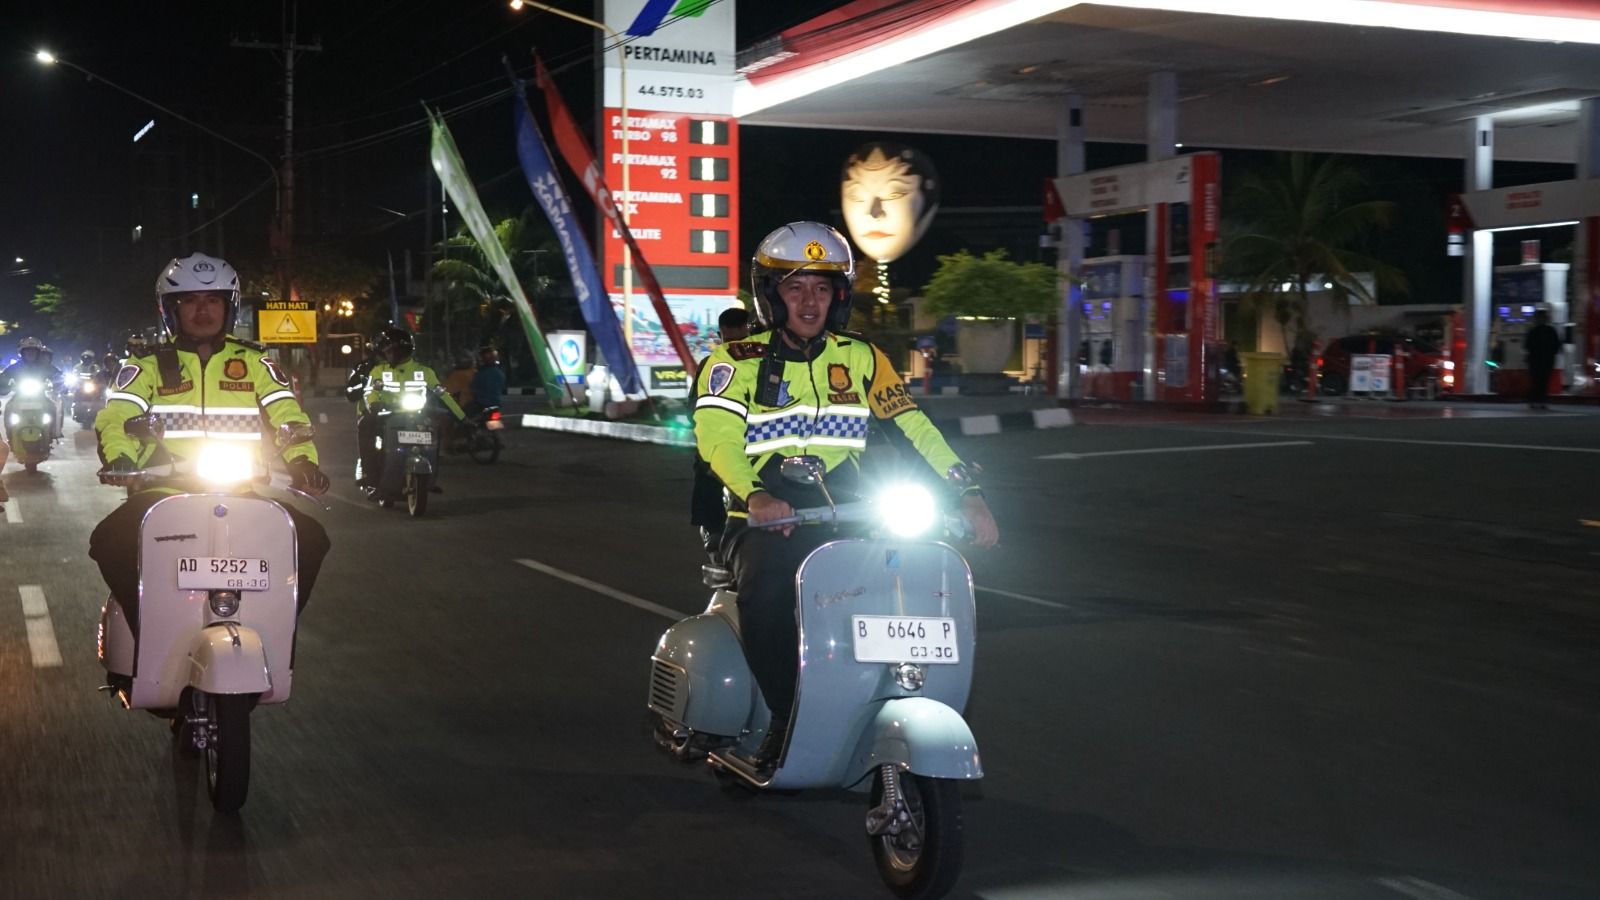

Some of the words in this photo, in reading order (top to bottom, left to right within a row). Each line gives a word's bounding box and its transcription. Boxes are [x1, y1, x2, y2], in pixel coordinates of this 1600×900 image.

[624, 45, 717, 65] PERTAMINA
[638, 85, 704, 99] 44.575.03
[661, 168, 678, 179] 92
[612, 228, 662, 240] DXLITE
[266, 302, 287, 310] HATI
[288, 302, 309, 310] HATI
[223, 383, 251, 391] POLRI
[180, 559, 198, 573] AD
[210, 559, 248, 574] 5252
[259, 560, 268, 573] B
[858, 620, 867, 638] B
[887, 621, 926, 639] 6646
[943, 622, 951, 639] P
